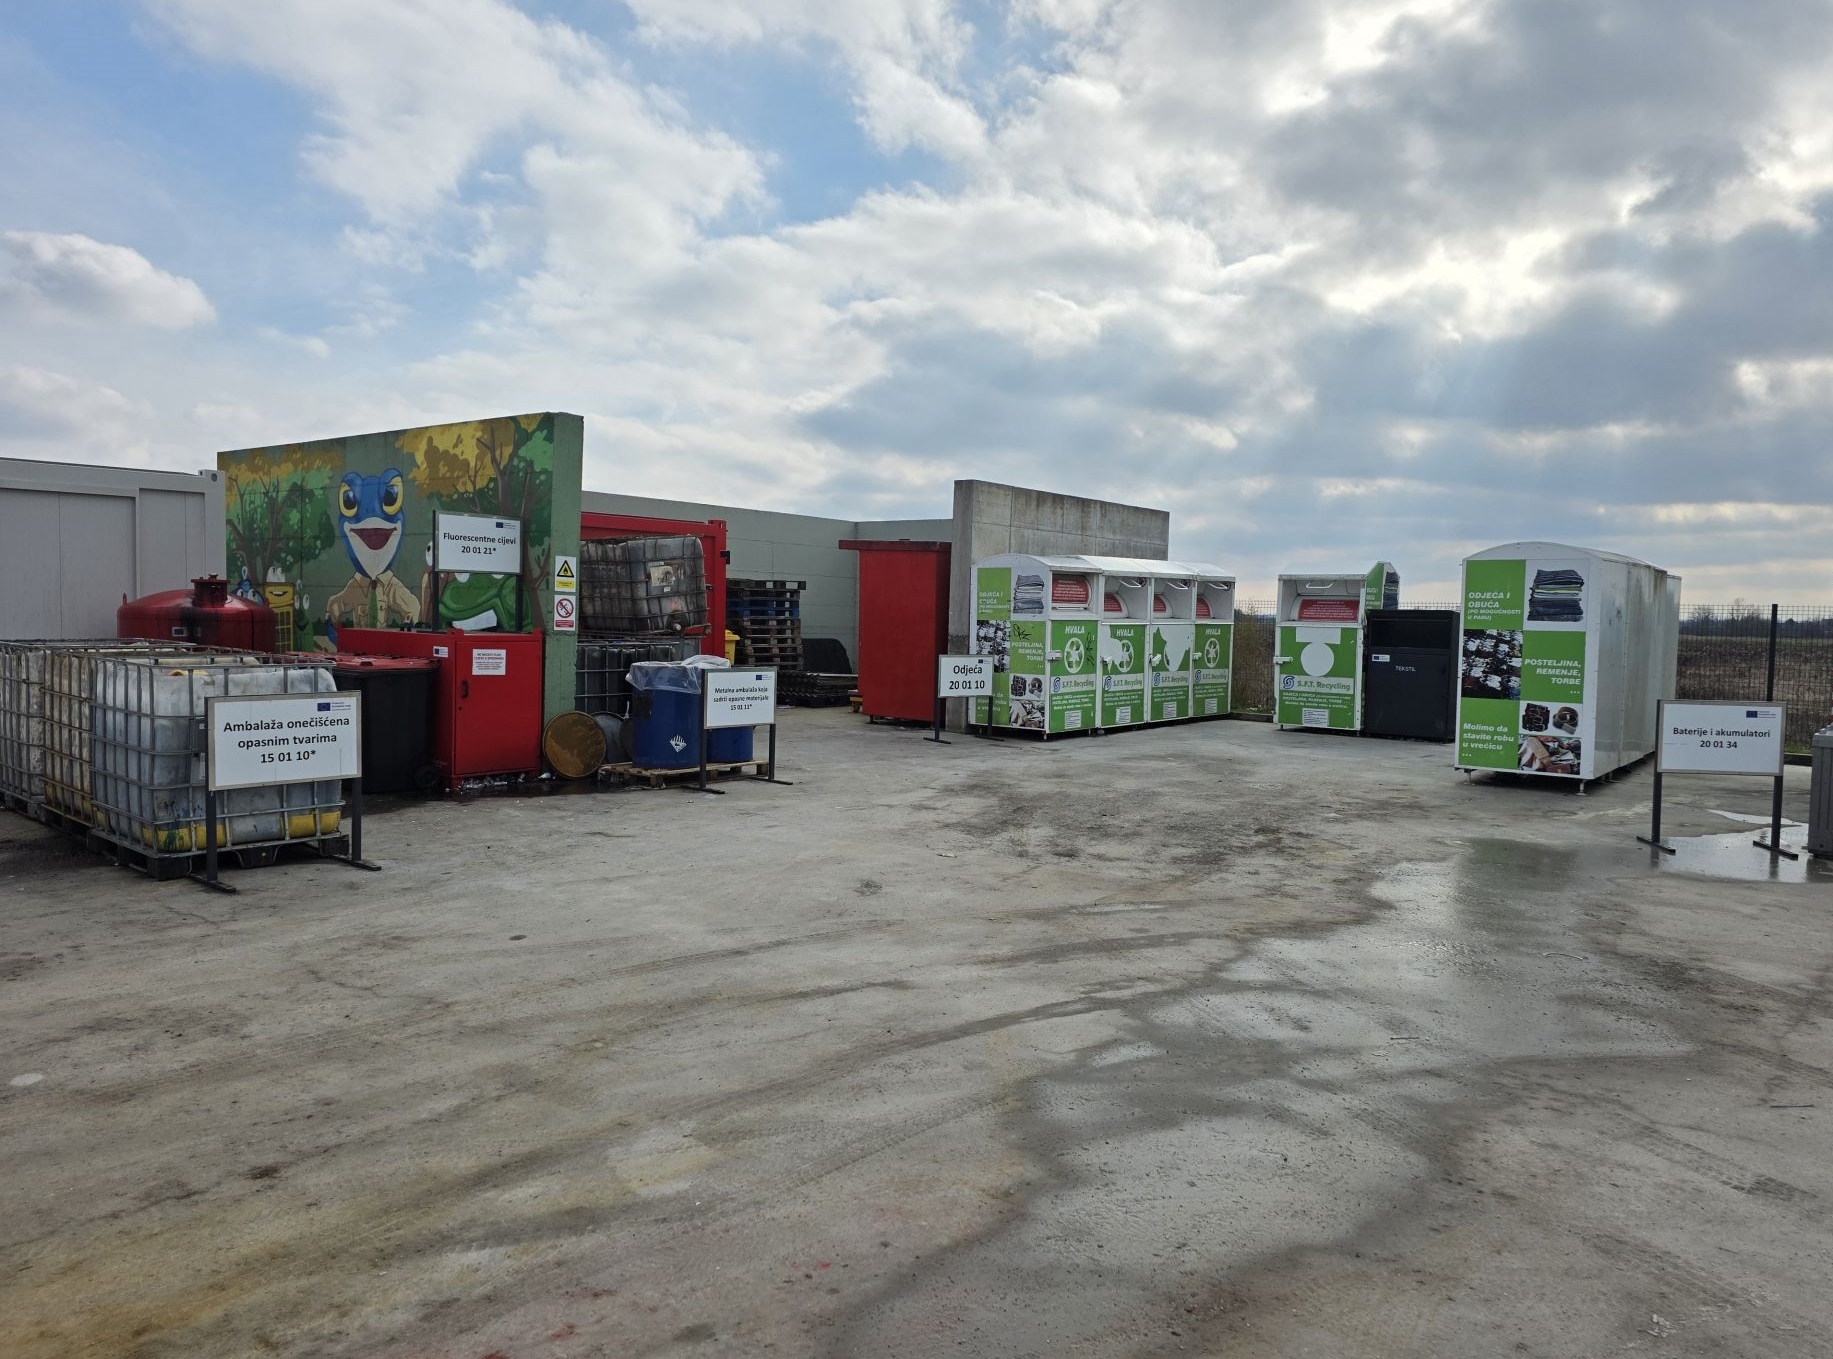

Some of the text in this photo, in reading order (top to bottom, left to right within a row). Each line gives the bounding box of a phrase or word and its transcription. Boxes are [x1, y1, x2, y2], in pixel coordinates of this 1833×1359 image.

[443, 533, 516, 545] Fluorescentne cijevi
[472, 546, 481, 554] 01
[1064, 625, 1085, 634] HVALA
[1116, 629, 1134, 637] HVALA
[1524, 659, 1582, 668] POSTELJINA,
[953, 664, 982, 676] Odjeća
[1536, 668, 1581, 677] REMENJE,
[949, 680, 985, 690] 20 01 10
[1297, 680, 1351, 691] S.F.T. Recycling
[1551, 677, 1581, 685] TORBE
[223, 717, 350, 732] Ambalaža onečišćena
[1463, 723, 1495, 731] Molimo
[1463, 732, 1514, 742] stavite robu
[1673, 727, 1708, 737] Baterije
[1715, 729, 1771, 738] akumulatori
[238, 734, 337, 750] opasnim tvarima
[1700, 740, 1711, 748] 20
[1726, 741, 1738, 749] 34
[260, 753, 275, 763] 15
[278, 752, 292, 762] 01
